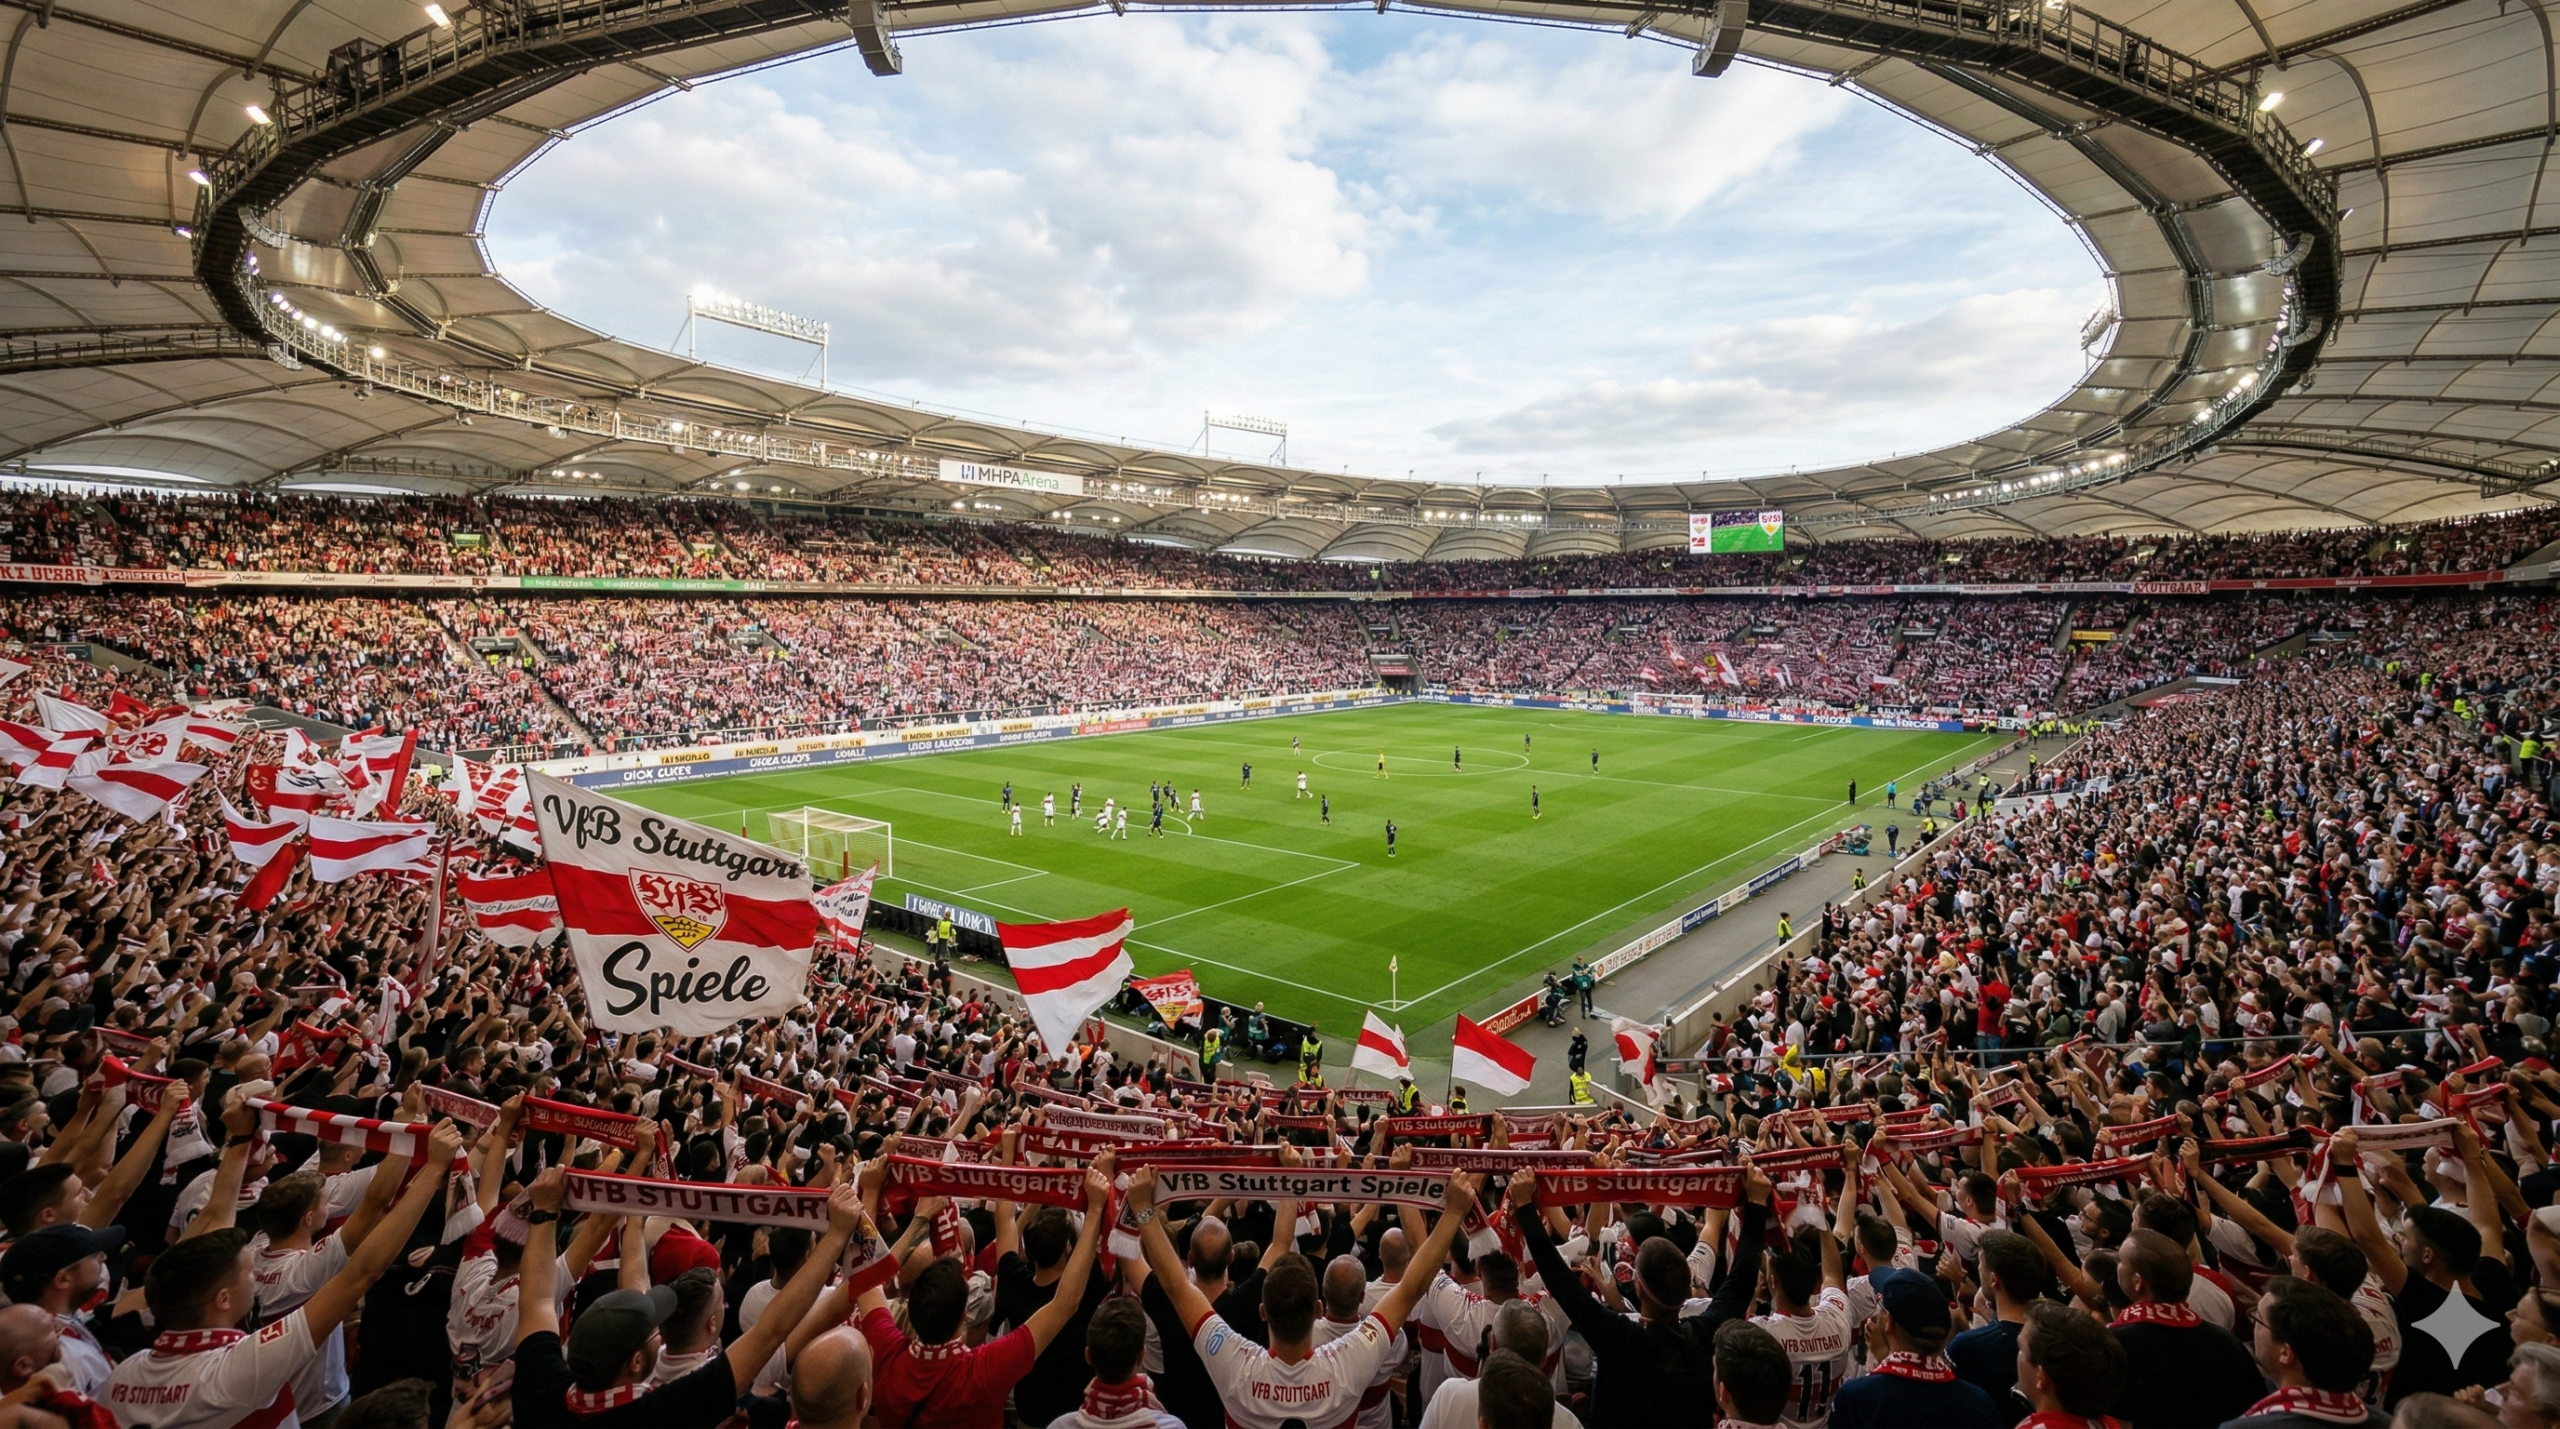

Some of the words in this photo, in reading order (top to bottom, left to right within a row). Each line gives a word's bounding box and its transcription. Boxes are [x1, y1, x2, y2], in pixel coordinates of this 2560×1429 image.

[543, 794, 621, 849] VfB
[633, 817, 800, 882] Stuttgart
[602, 941, 771, 1016] Spiele
[891, 1163, 933, 1184] VfB
[1544, 1175, 1589, 1193] VfB
[1160, 1174, 1210, 1192] VfB
[1219, 1173, 1351, 1195] Stuttgart
[1360, 1176, 1445, 1199] Spiele
[128, 1384, 190, 1405] STUTTGART
[1252, 1381, 1271, 1400] VFB
[1273, 1381, 1331, 1403] STUTTGART
[1797, 1361, 1832, 1423] 11
